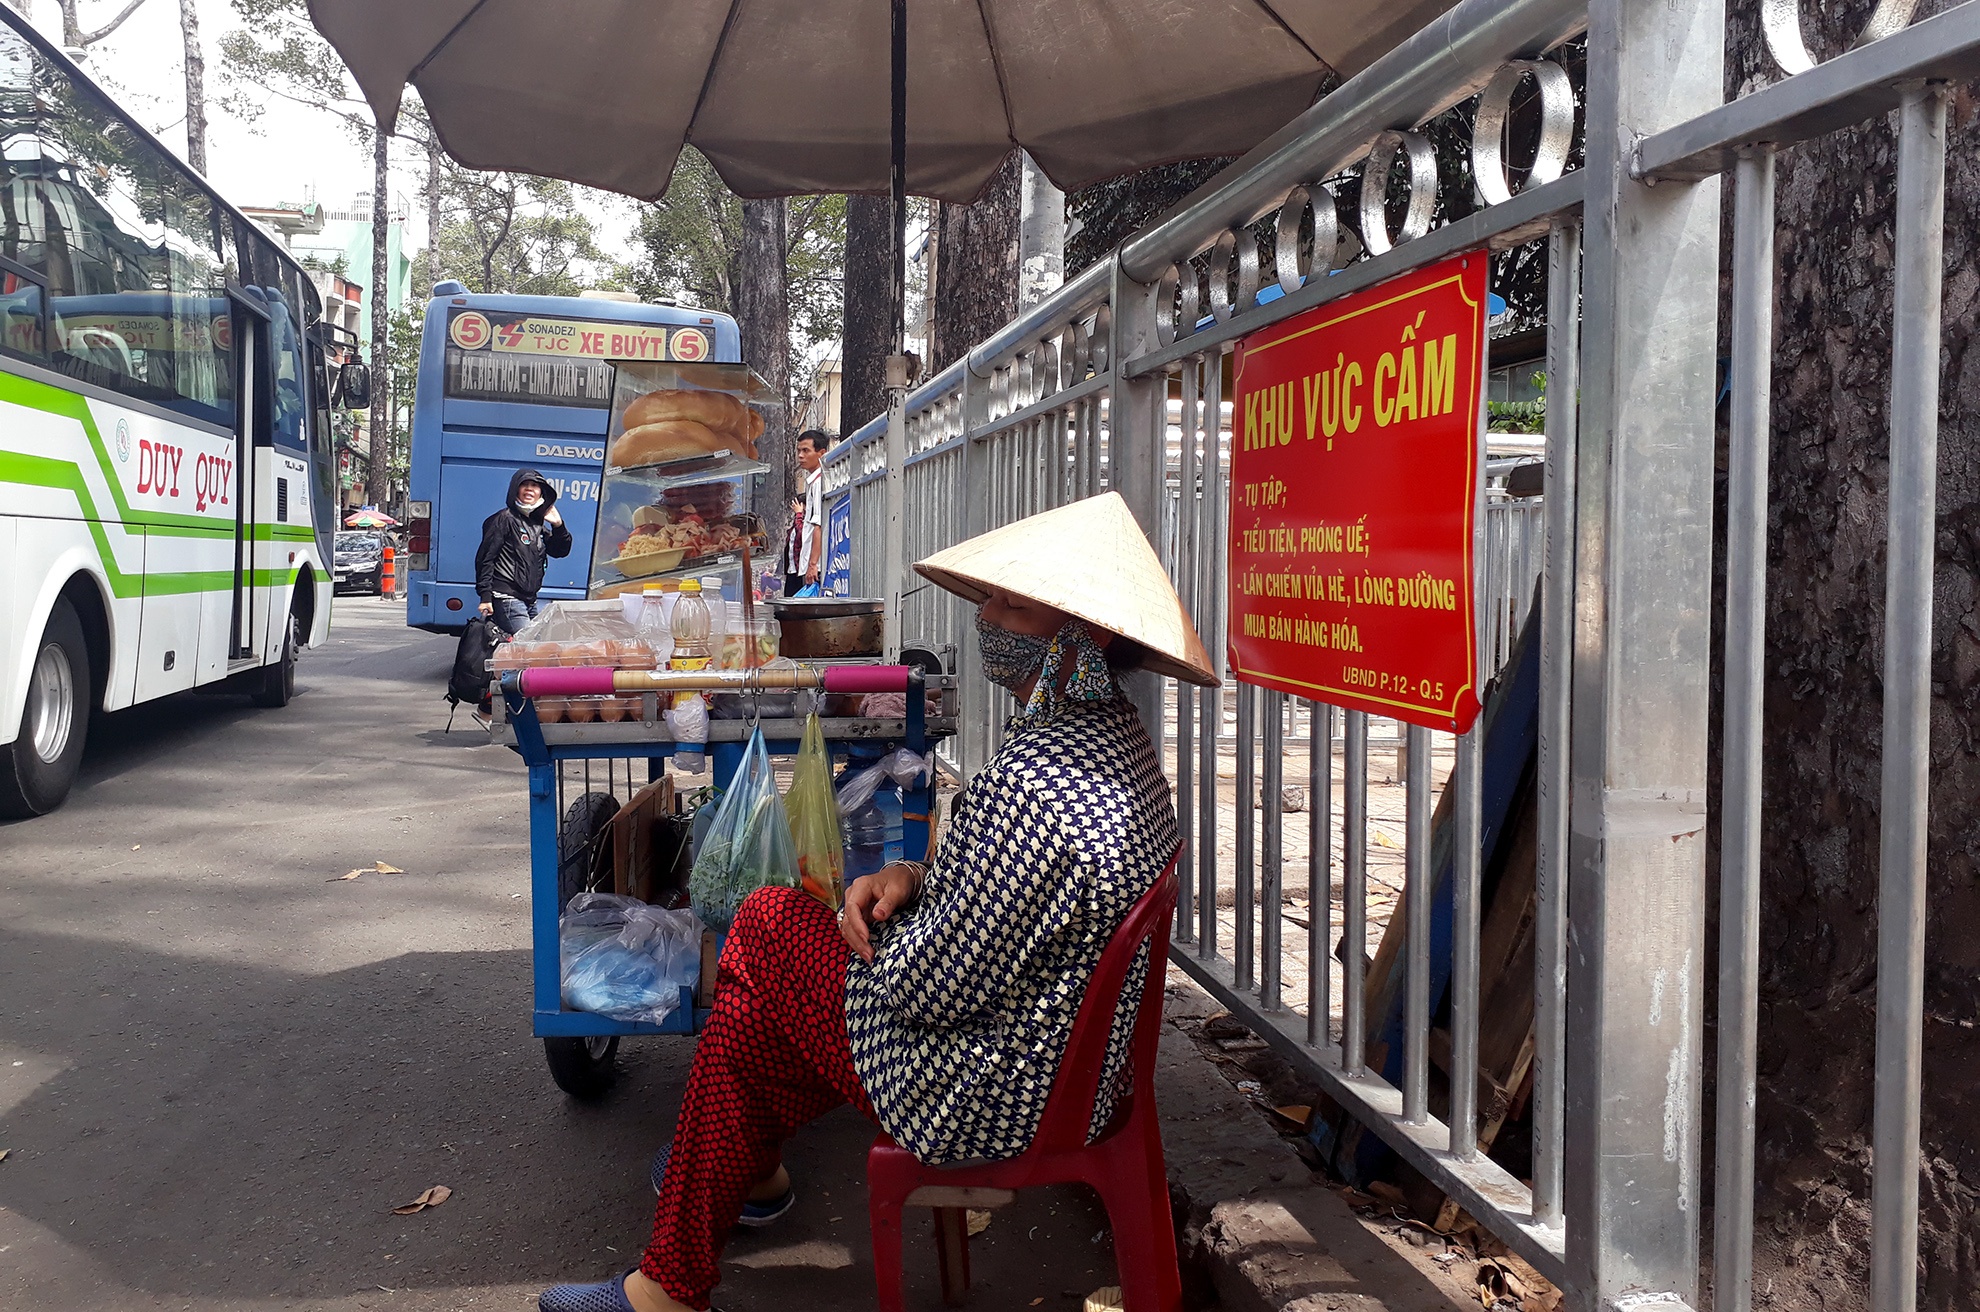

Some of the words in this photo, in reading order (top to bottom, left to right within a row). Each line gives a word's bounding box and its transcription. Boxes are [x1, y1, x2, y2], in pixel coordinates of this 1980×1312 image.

[460, 318, 482, 343] 5
[528, 323, 576, 337] SONADEZI
[533, 336, 570, 351] TJC
[579, 331, 605, 355] XE
[611, 330, 663, 359] BUÝT
[679, 335, 700, 360] 5
[500, 354, 521, 393] HÒA
[529, 361, 551, 396] LINH
[552, 358, 578, 397] XUÂN
[1244, 380, 1294, 452] KHU
[1302, 352, 1363, 452] VỰC
[1373, 309, 1457, 428] CẤM
[137, 439, 183, 498] DUY
[195, 443, 232, 512] QUÝ
[1245, 483, 1259, 511] TỤ
[1262, 474, 1287, 509] TẬP;
[1243, 517, 1266, 553] TIỂU
[1269, 522, 1297, 558] TIỆN,
[1301, 519, 1343, 553] PHÓNG
[1346, 513, 1370, 559] UẾ;
[1243, 563, 1263, 596] LẤN
[1265, 564, 1302, 599] CHIẾM
[1304, 565, 1325, 600] VỈA
[1328, 568, 1351, 609] HÈ,
[1354, 568, 1395, 606] LÒNG
[1398, 570, 1456, 611] ĐƯỜNG
[1244, 613, 1266, 639] MUA
[1269, 610, 1292, 643] BÁN
[1295, 612, 1328, 649] HÀNG
[1332, 617, 1363, 653] HÓA.
[1342, 666, 1377, 688] UBND
[1380, 672, 1407, 694] P.12
[1419, 679, 1444, 701] Q.5
